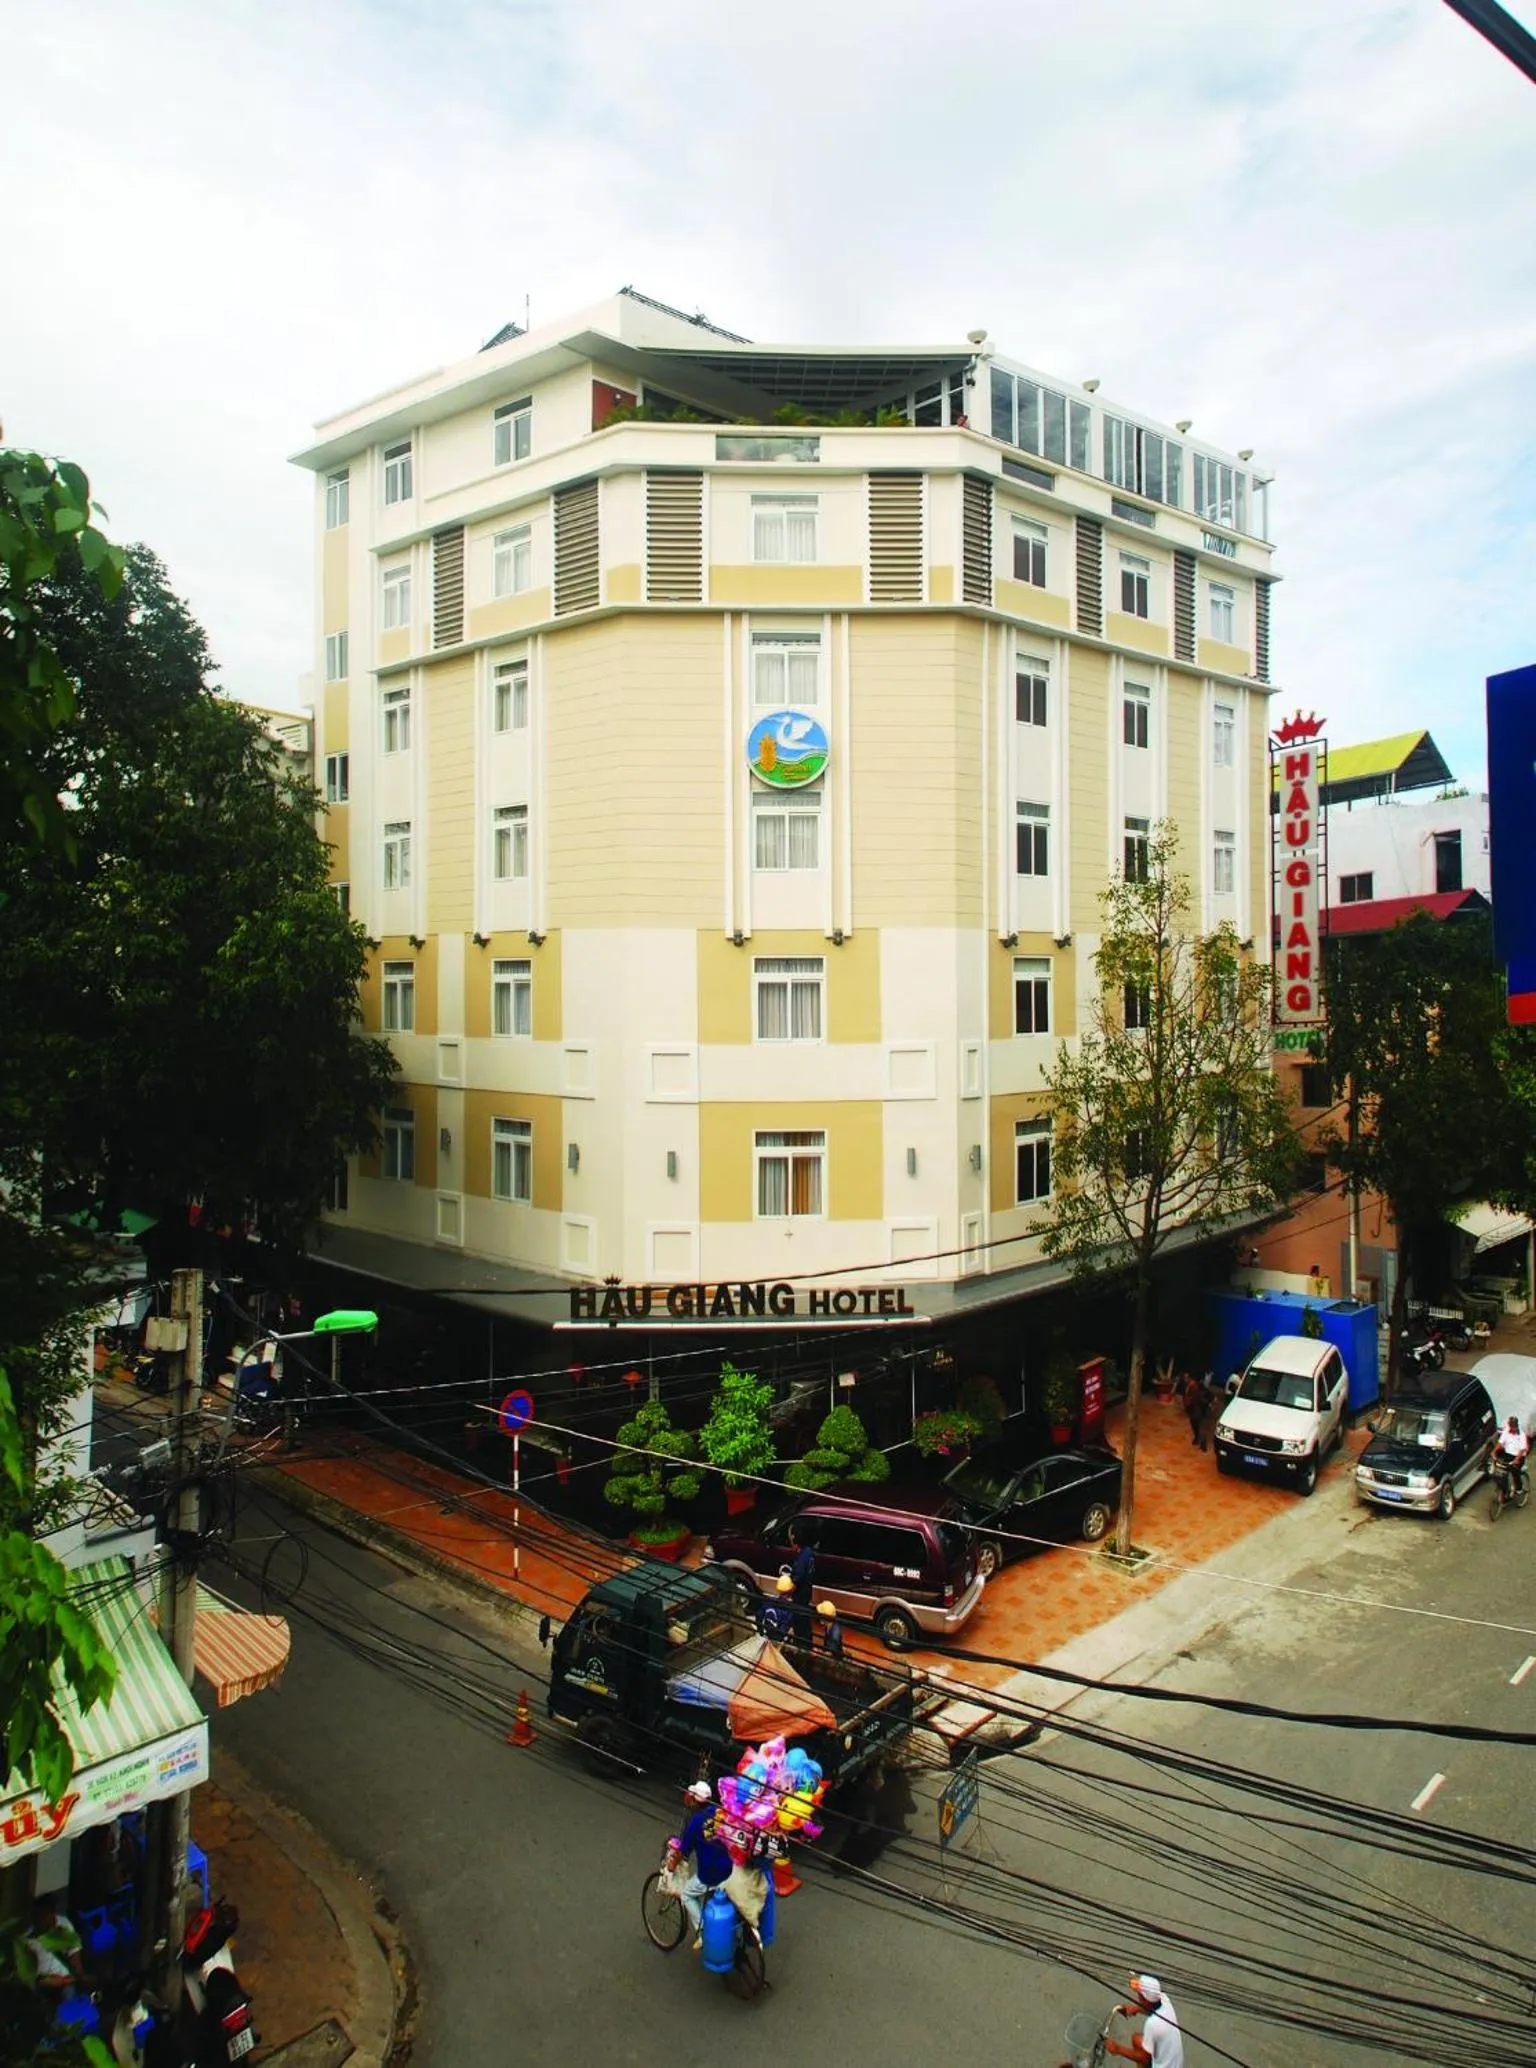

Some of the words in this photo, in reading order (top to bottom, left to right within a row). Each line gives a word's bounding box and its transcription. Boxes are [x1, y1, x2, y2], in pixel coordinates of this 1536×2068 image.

[1286, 752, 1310, 847] HẬU
[1286, 861, 1311, 1012] GIANG
[666, 1283, 795, 1319] GIANG
[809, 1288, 914, 1315] HOTEL
